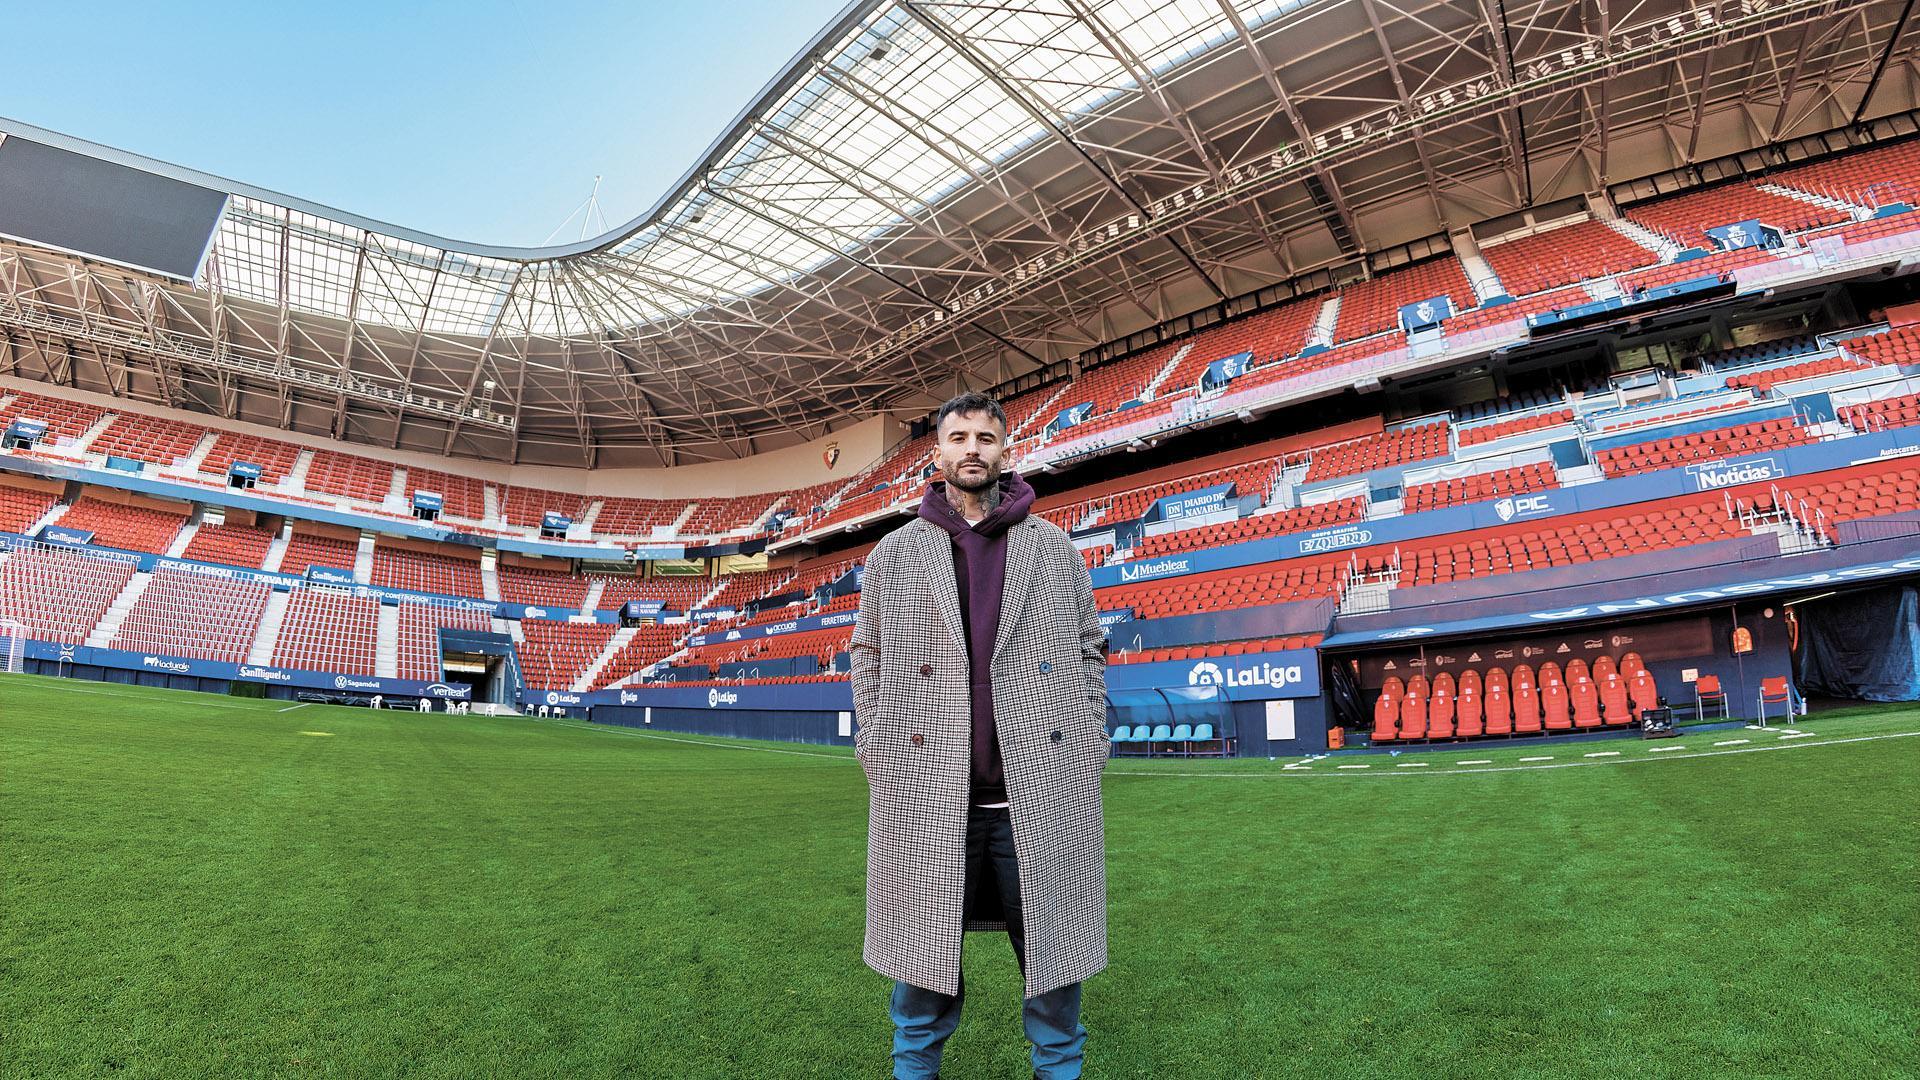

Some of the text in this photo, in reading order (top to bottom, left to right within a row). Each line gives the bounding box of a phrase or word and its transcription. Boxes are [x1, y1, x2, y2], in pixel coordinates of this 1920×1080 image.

[1880, 445, 1919, 456] Autocares
[1699, 465, 1771, 489] Noticias
[1184, 495, 1212, 508] DIARIO
[1516, 495, 1549, 513] PIC
[1168, 504, 1181, 515] DN
[1300, 530, 1372, 553] EZQUERRO
[1139, 559, 1188, 576] Mueblear
[253, 573, 299, 587] PAVANA
[821, 614, 853, 626] FERRETERIA
[1227, 662, 1302, 689] LaLiga
[347, 680, 380, 689] Sagamóvil
[560, 695, 581, 704] LaLiga
[626, 692, 638, 702] LaLiga
[718, 691, 738, 704] LaLiga
